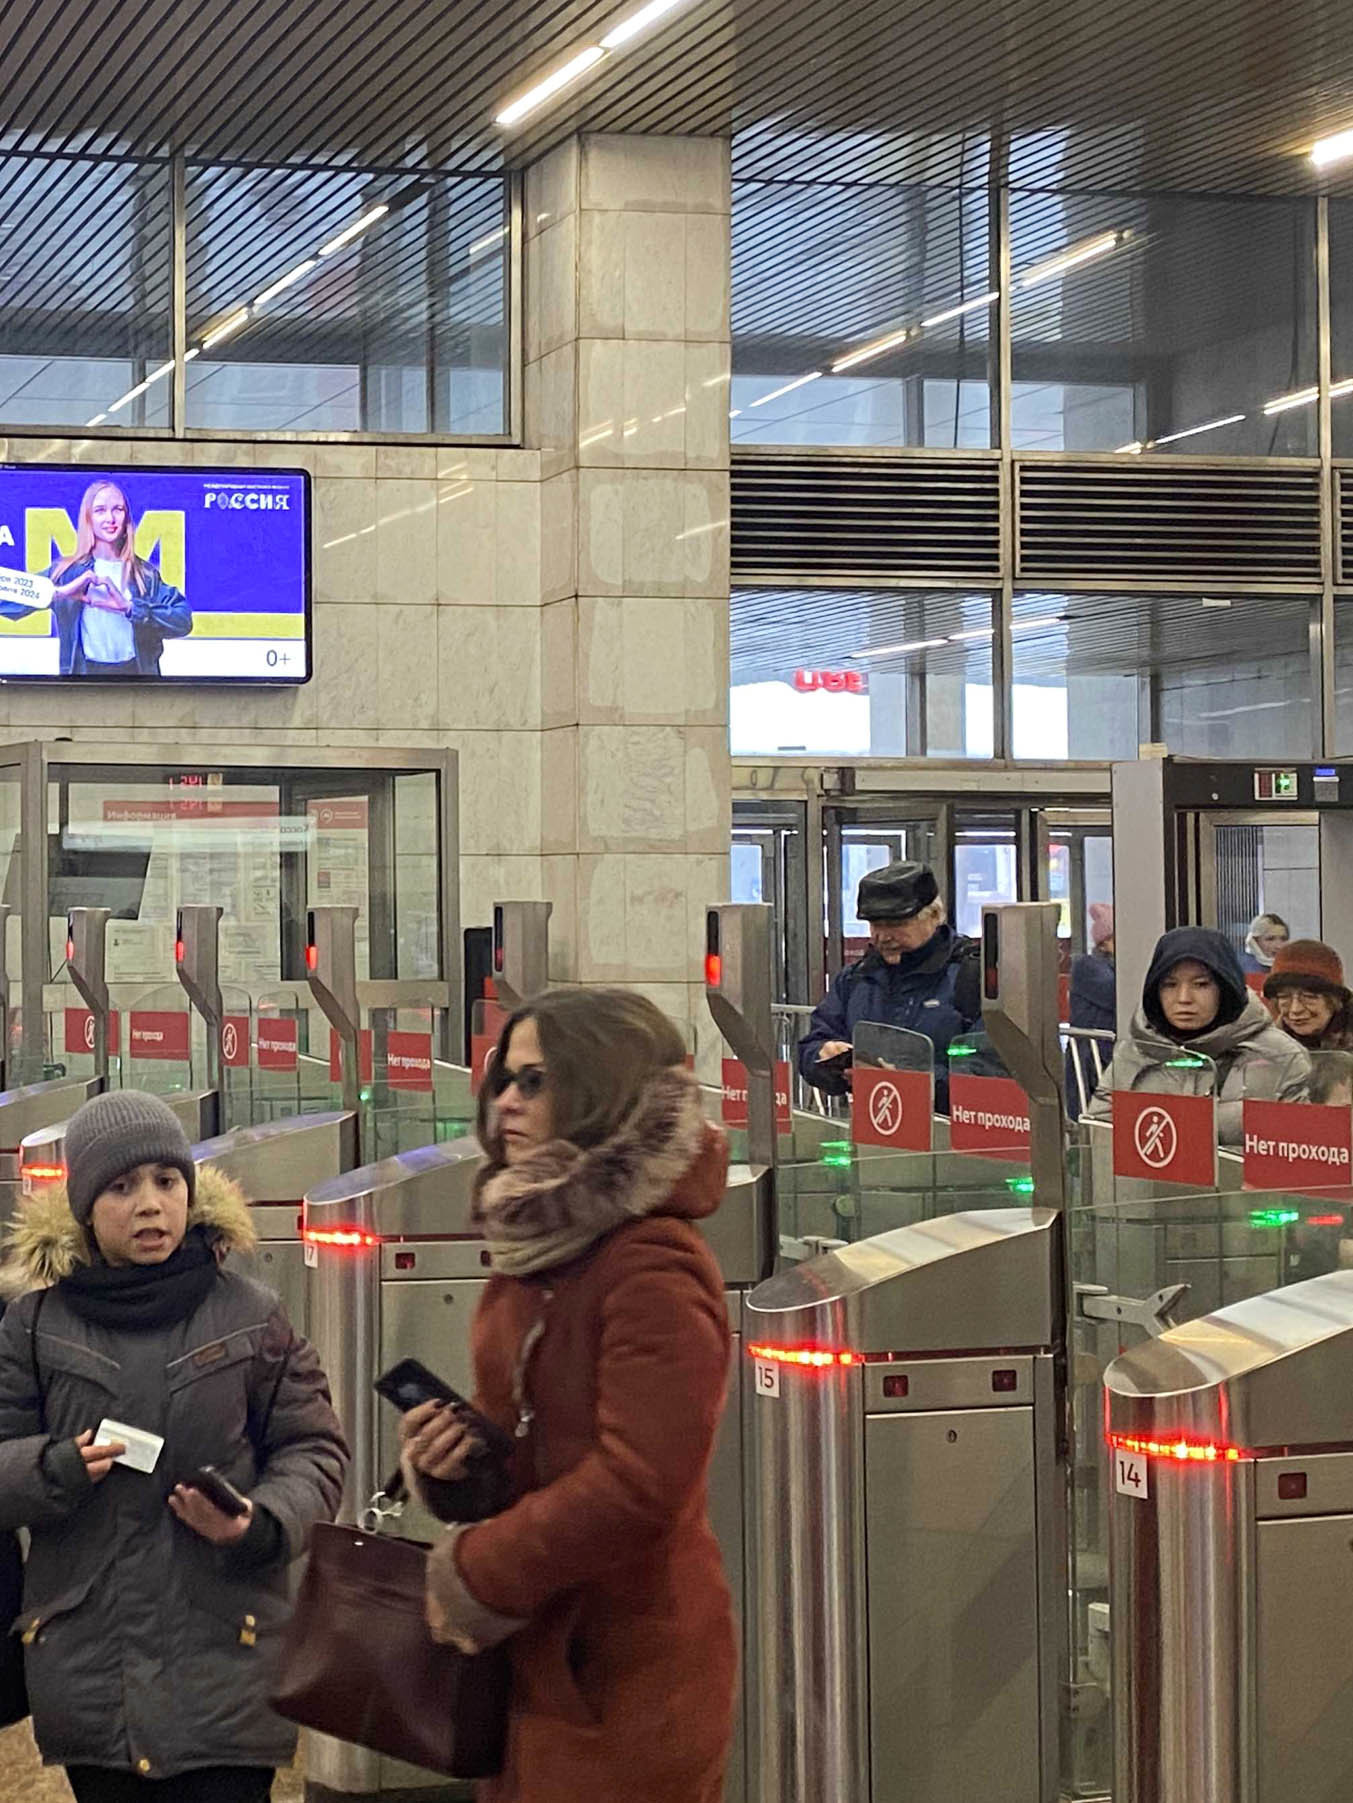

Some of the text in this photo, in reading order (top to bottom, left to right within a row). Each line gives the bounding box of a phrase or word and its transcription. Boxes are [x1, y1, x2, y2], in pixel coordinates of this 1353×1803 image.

[204, 492, 291, 511] РОССИЯ
[266, 649, 292, 667] 0+
[387, 1053, 401, 1067] Нет
[952, 1105, 1031, 1133] Нет прохода
[1245, 1133, 1349, 1166] Нет прохода
[758, 1366, 775, 1388] 15
[1120, 1461, 1142, 1488] 14
